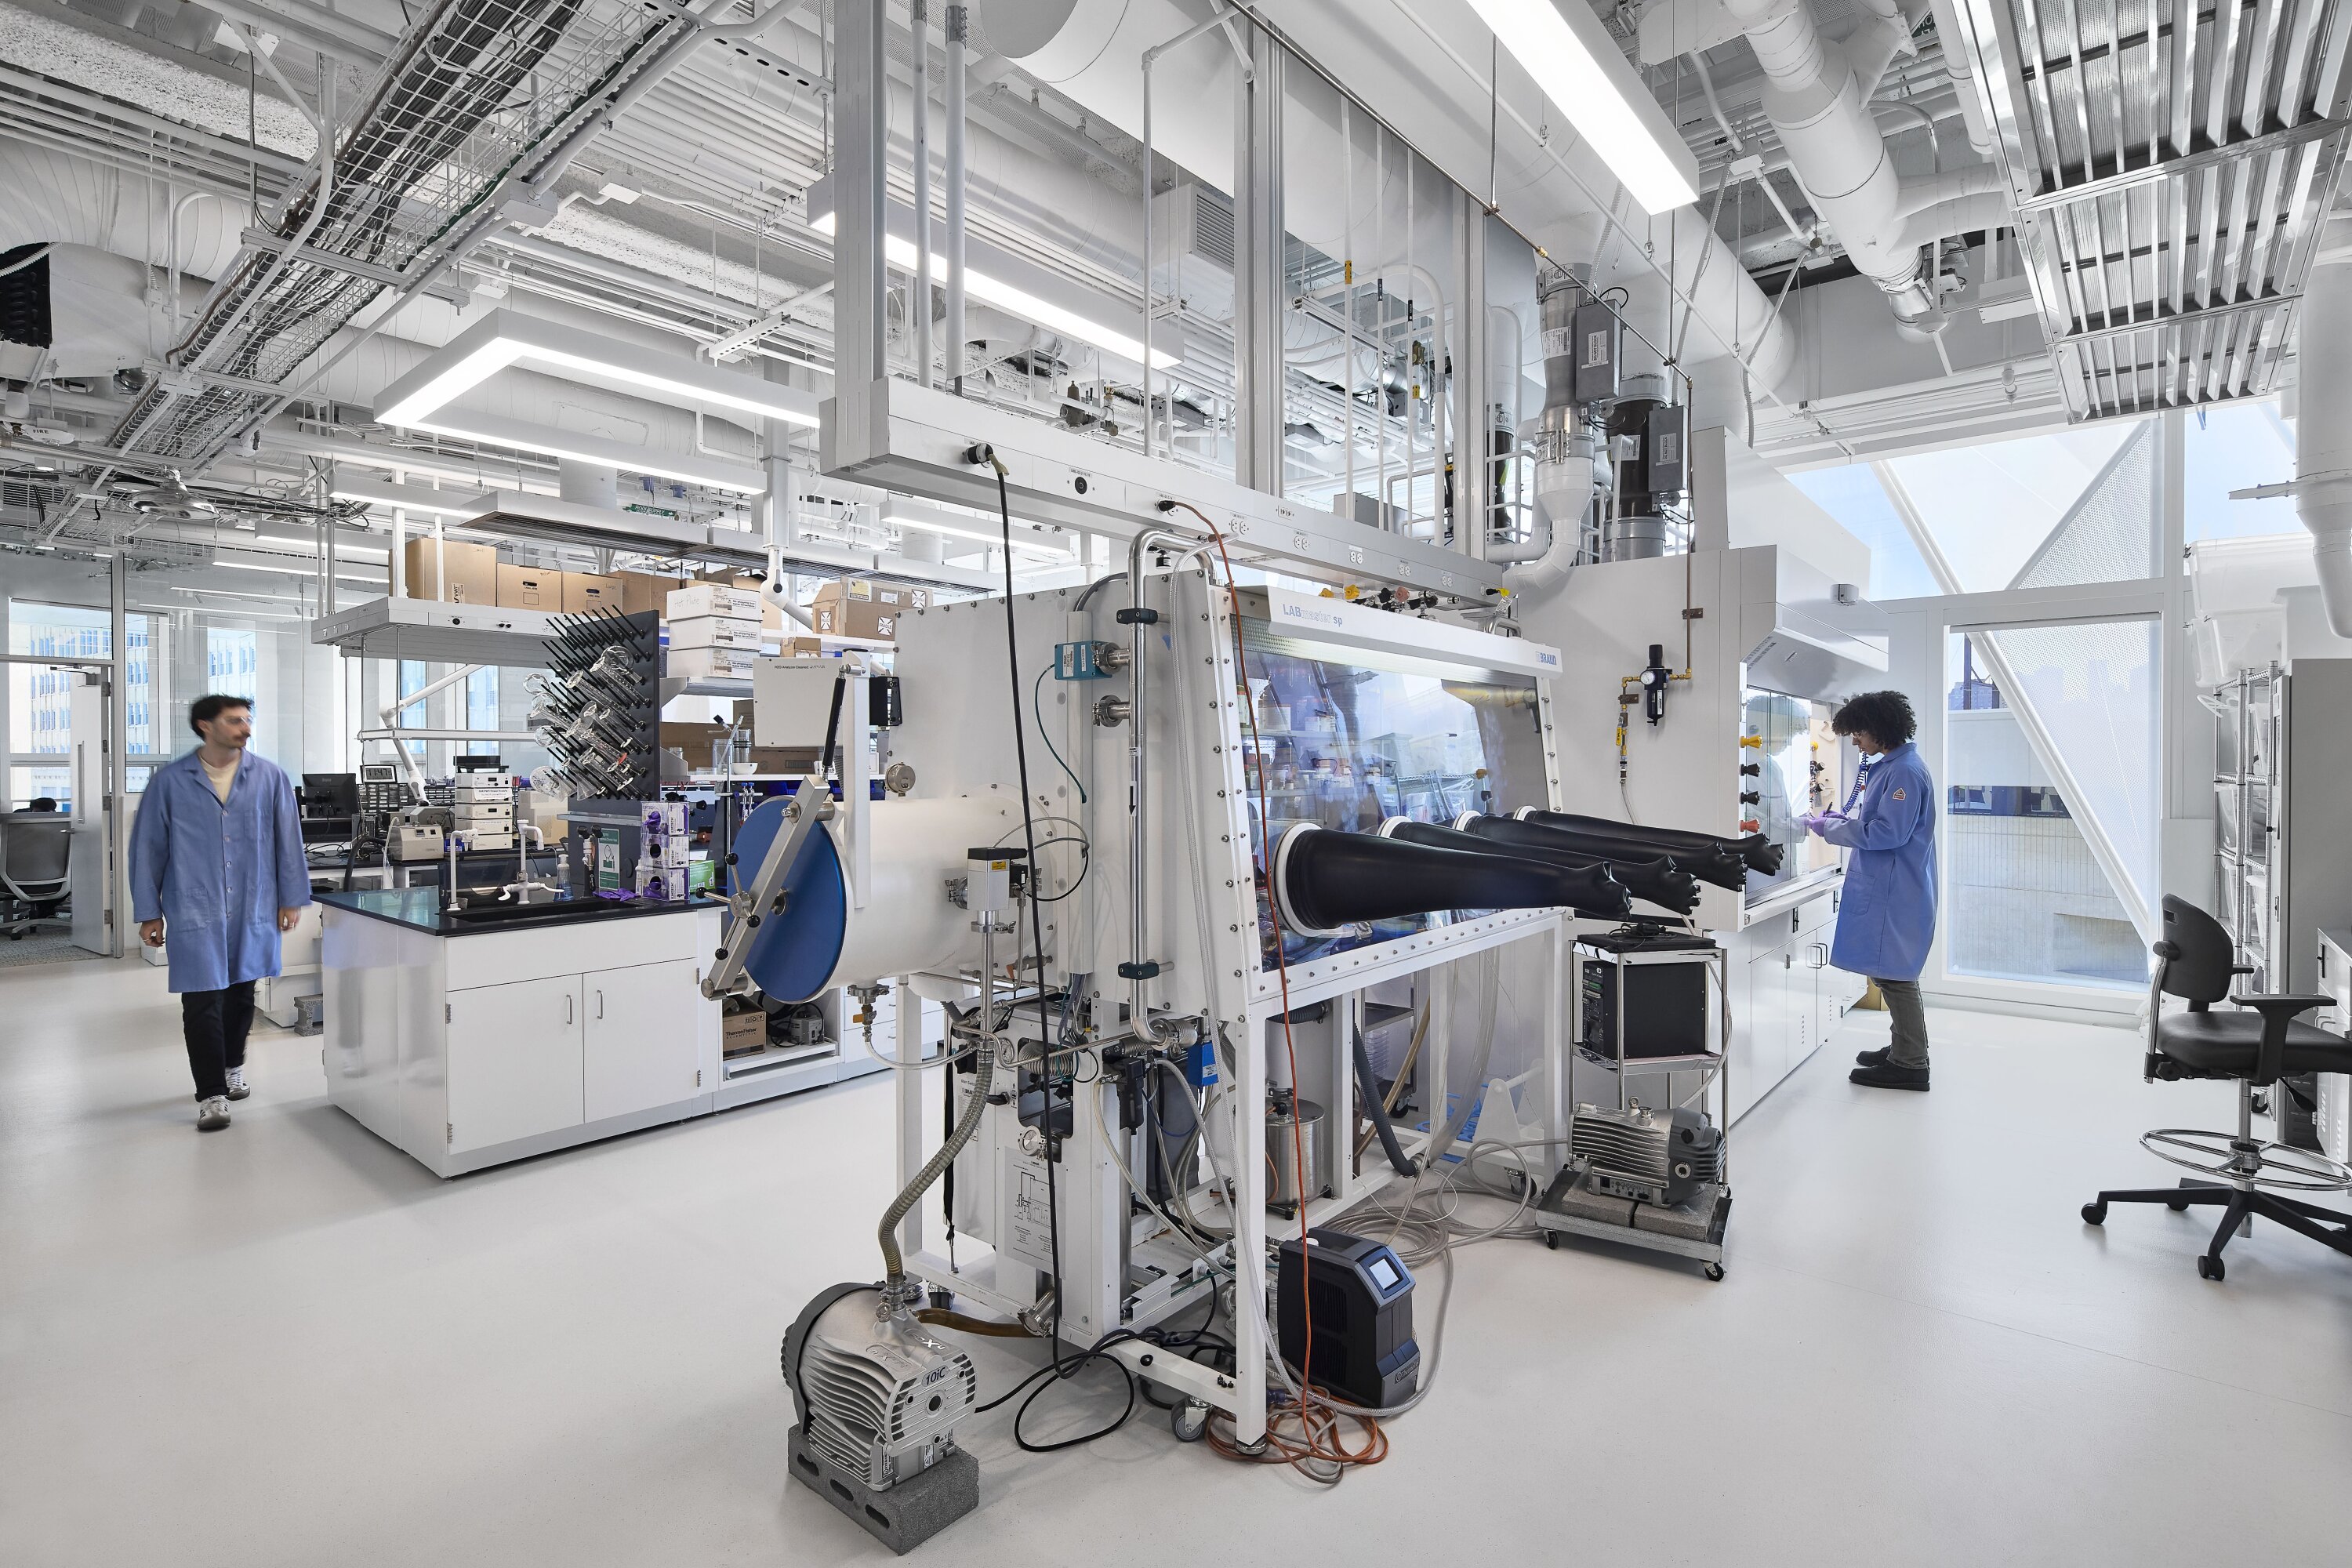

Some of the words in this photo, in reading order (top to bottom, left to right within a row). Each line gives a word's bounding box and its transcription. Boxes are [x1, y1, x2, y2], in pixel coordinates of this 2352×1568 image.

[1283, 604, 1332, 623] LABmaster
[1333, 616, 1343, 627] sp
[726, 1028, 757, 1036] ThermoFisher
[926, 1367, 946, 1385] 10iC
